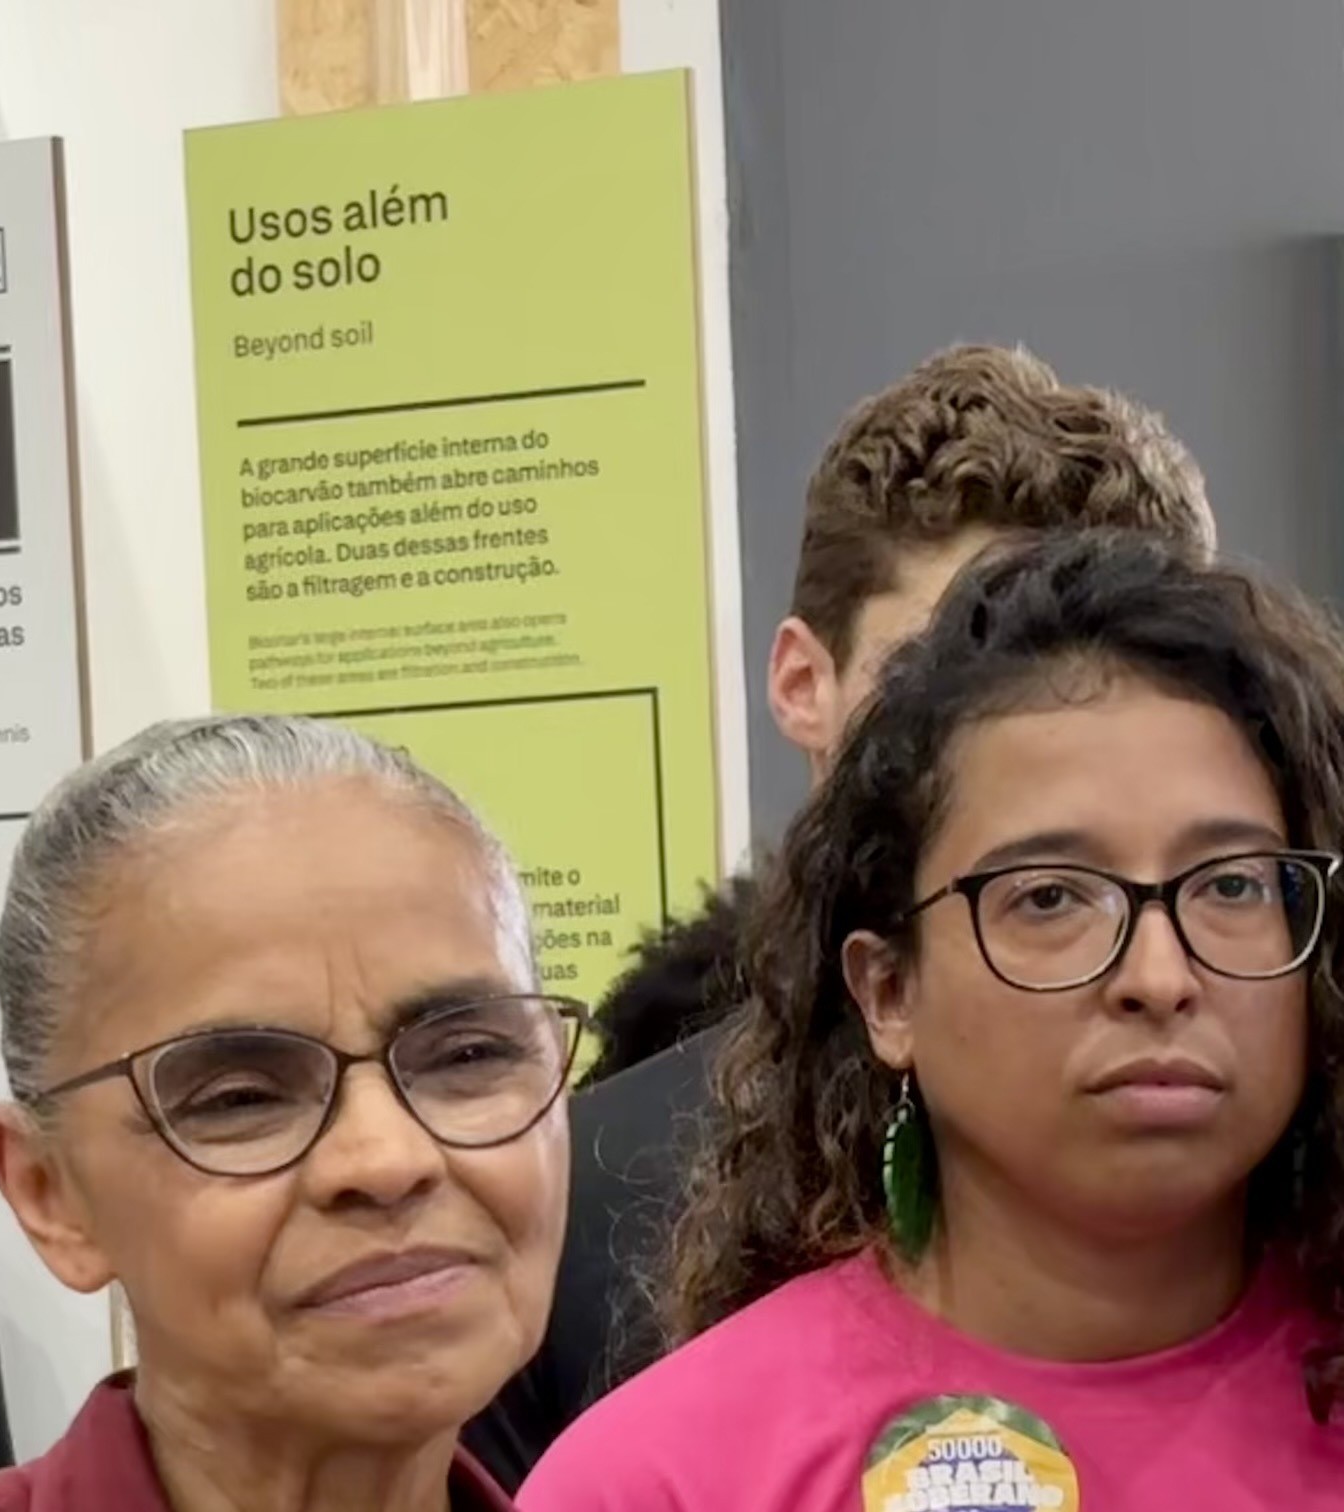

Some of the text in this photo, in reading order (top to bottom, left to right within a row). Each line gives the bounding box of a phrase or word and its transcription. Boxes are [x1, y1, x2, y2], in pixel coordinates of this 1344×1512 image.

[228, 183, 449, 245] Usos além
[230, 245, 382, 298] do solo
[233, 319, 374, 361] Beyond soil
[239, 457, 254, 477] A
[257, 450, 330, 481] grande
[441, 434, 520, 458] interna
[522, 428, 550, 451] do
[241, 458, 601, 509] biocarvão também abre caminhos
[243, 495, 538, 543] para aplicações além do uso
[244, 527, 549, 575] agrícola. Duas dessas frentes
[246, 554, 560, 602] são a filtragem e a construção.
[567, 869, 581, 887] o
[532, 892, 621, 918] material
[586, 930, 613, 947] na
